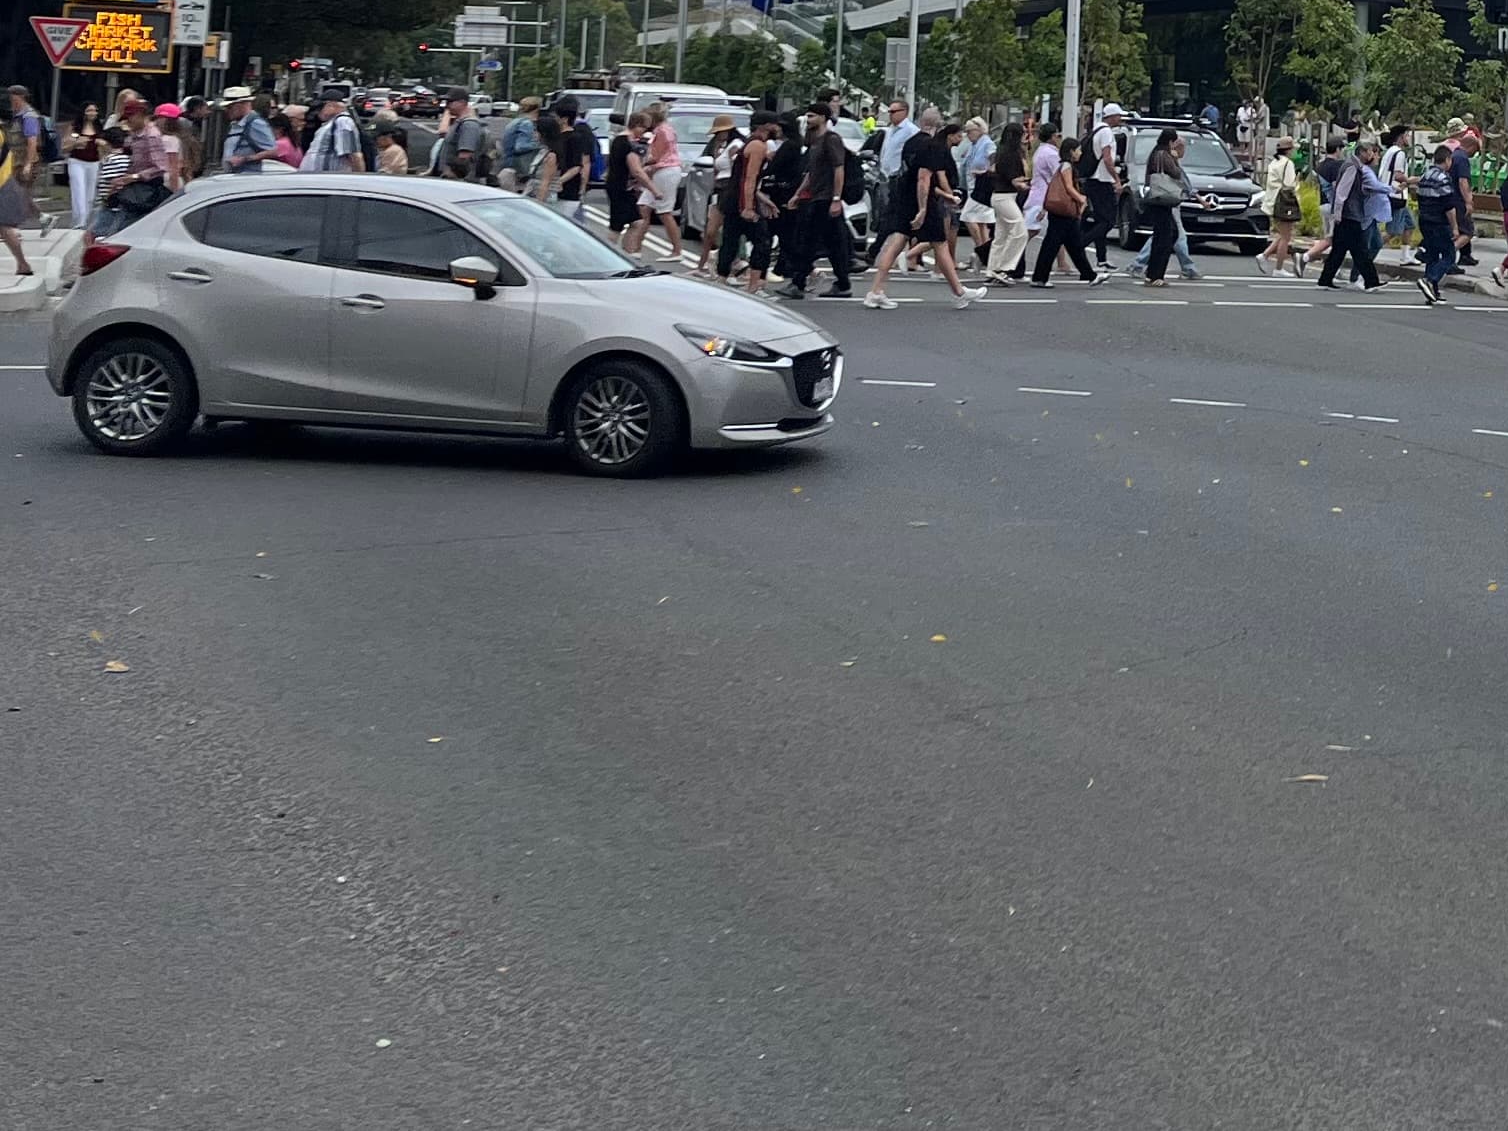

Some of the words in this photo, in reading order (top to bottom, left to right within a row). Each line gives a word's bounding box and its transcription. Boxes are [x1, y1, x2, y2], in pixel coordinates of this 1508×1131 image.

[96, 11, 142, 26] FISH
[46, 26, 73, 35] GIVE
[82, 23, 154, 39] MARKET
[75, 36, 158, 51] CARPARK
[90, 49, 139, 63] FULL
